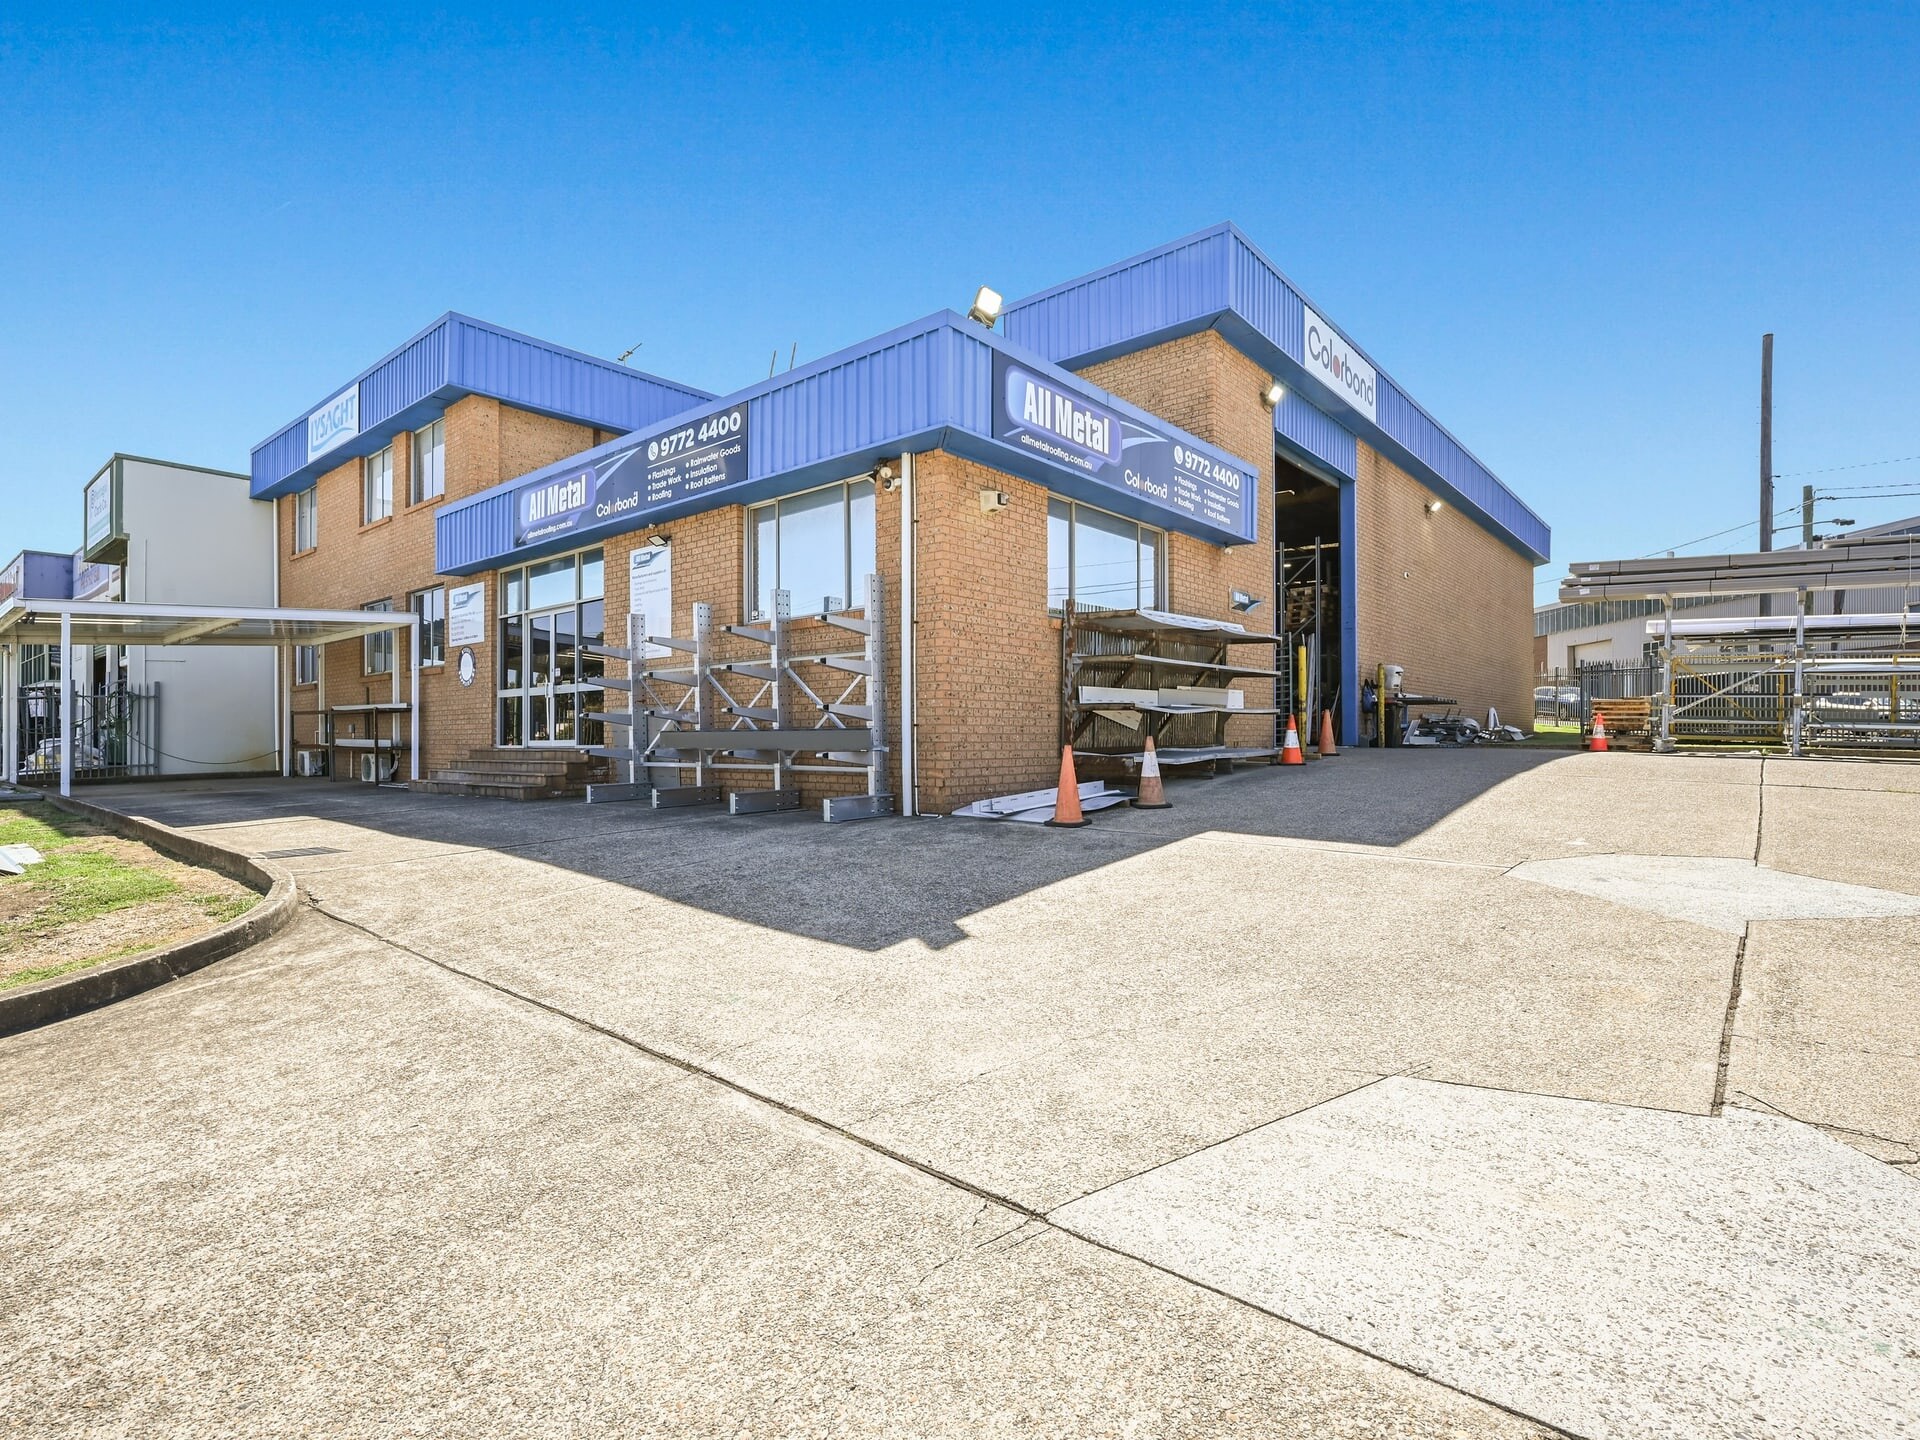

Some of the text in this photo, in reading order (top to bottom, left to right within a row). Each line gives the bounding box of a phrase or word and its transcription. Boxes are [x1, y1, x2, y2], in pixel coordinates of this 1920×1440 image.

[1308, 325, 1374, 407] Colorbond
[1024, 381, 1110, 455] All Metal
[660, 412, 741, 457] 9772 4400
[690, 444, 741, 467] Rainwater Goods
[1021, 434, 1093, 470] allmetalroofing.com.au
[652, 467, 676, 480] Flashings
[652, 474, 682, 491] Trade Work
[690, 463, 718, 478] Insulation
[690, 473, 726, 490] Roof Battens
[1124, 469, 1168, 499] Colorbond
[1185, 450, 1240, 490] 9772 4400
[529, 474, 586, 522] All Metal
[596, 491, 639, 518] Colorbond
[652, 489, 672, 501] Roofing
